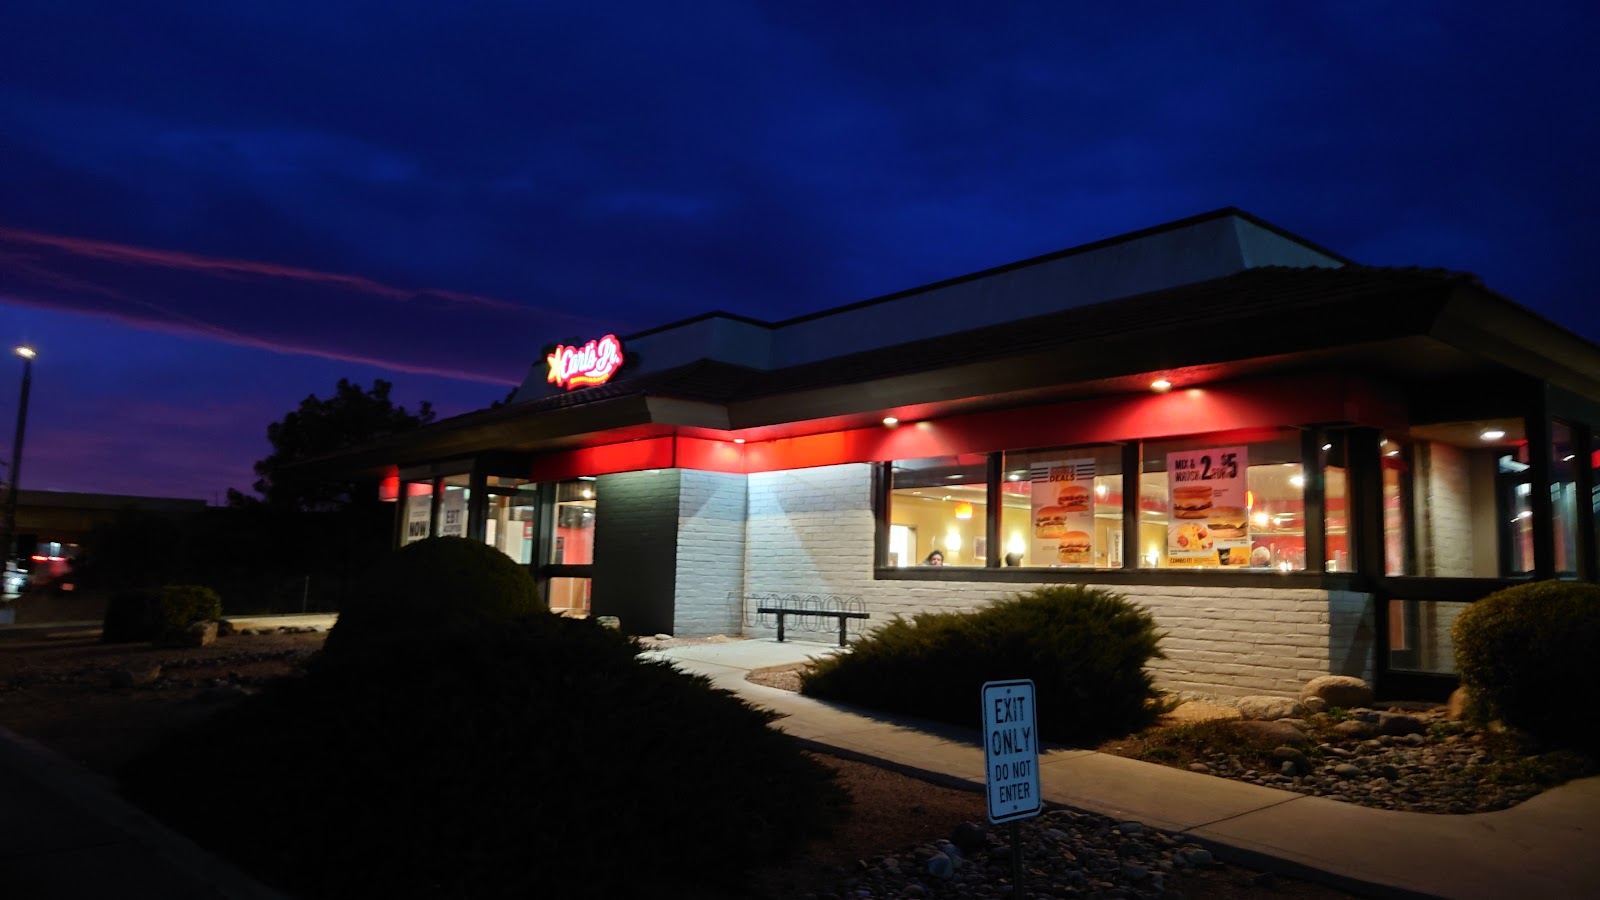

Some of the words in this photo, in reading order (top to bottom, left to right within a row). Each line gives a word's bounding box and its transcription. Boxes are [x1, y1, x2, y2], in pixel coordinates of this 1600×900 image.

[560, 343, 597, 379] Carl's
[596, 338, 620, 372] Jr.
[1175, 459, 1188, 470] MIX
[1189, 460, 1196, 468] &
[1200, 455, 1212, 480] 2
[1049, 473, 1075, 482] DEALS
[446, 510, 460, 524] EBT
[410, 521, 426, 537] NOW
[1170, 556, 1187, 564] COMBO
[994, 697, 1025, 724] EXIT
[992, 727, 1031, 756] ONLY
[995, 763, 1009, 782] DO
[1012, 760, 1031, 778] NOT
[999, 782, 1031, 803] ENTER
